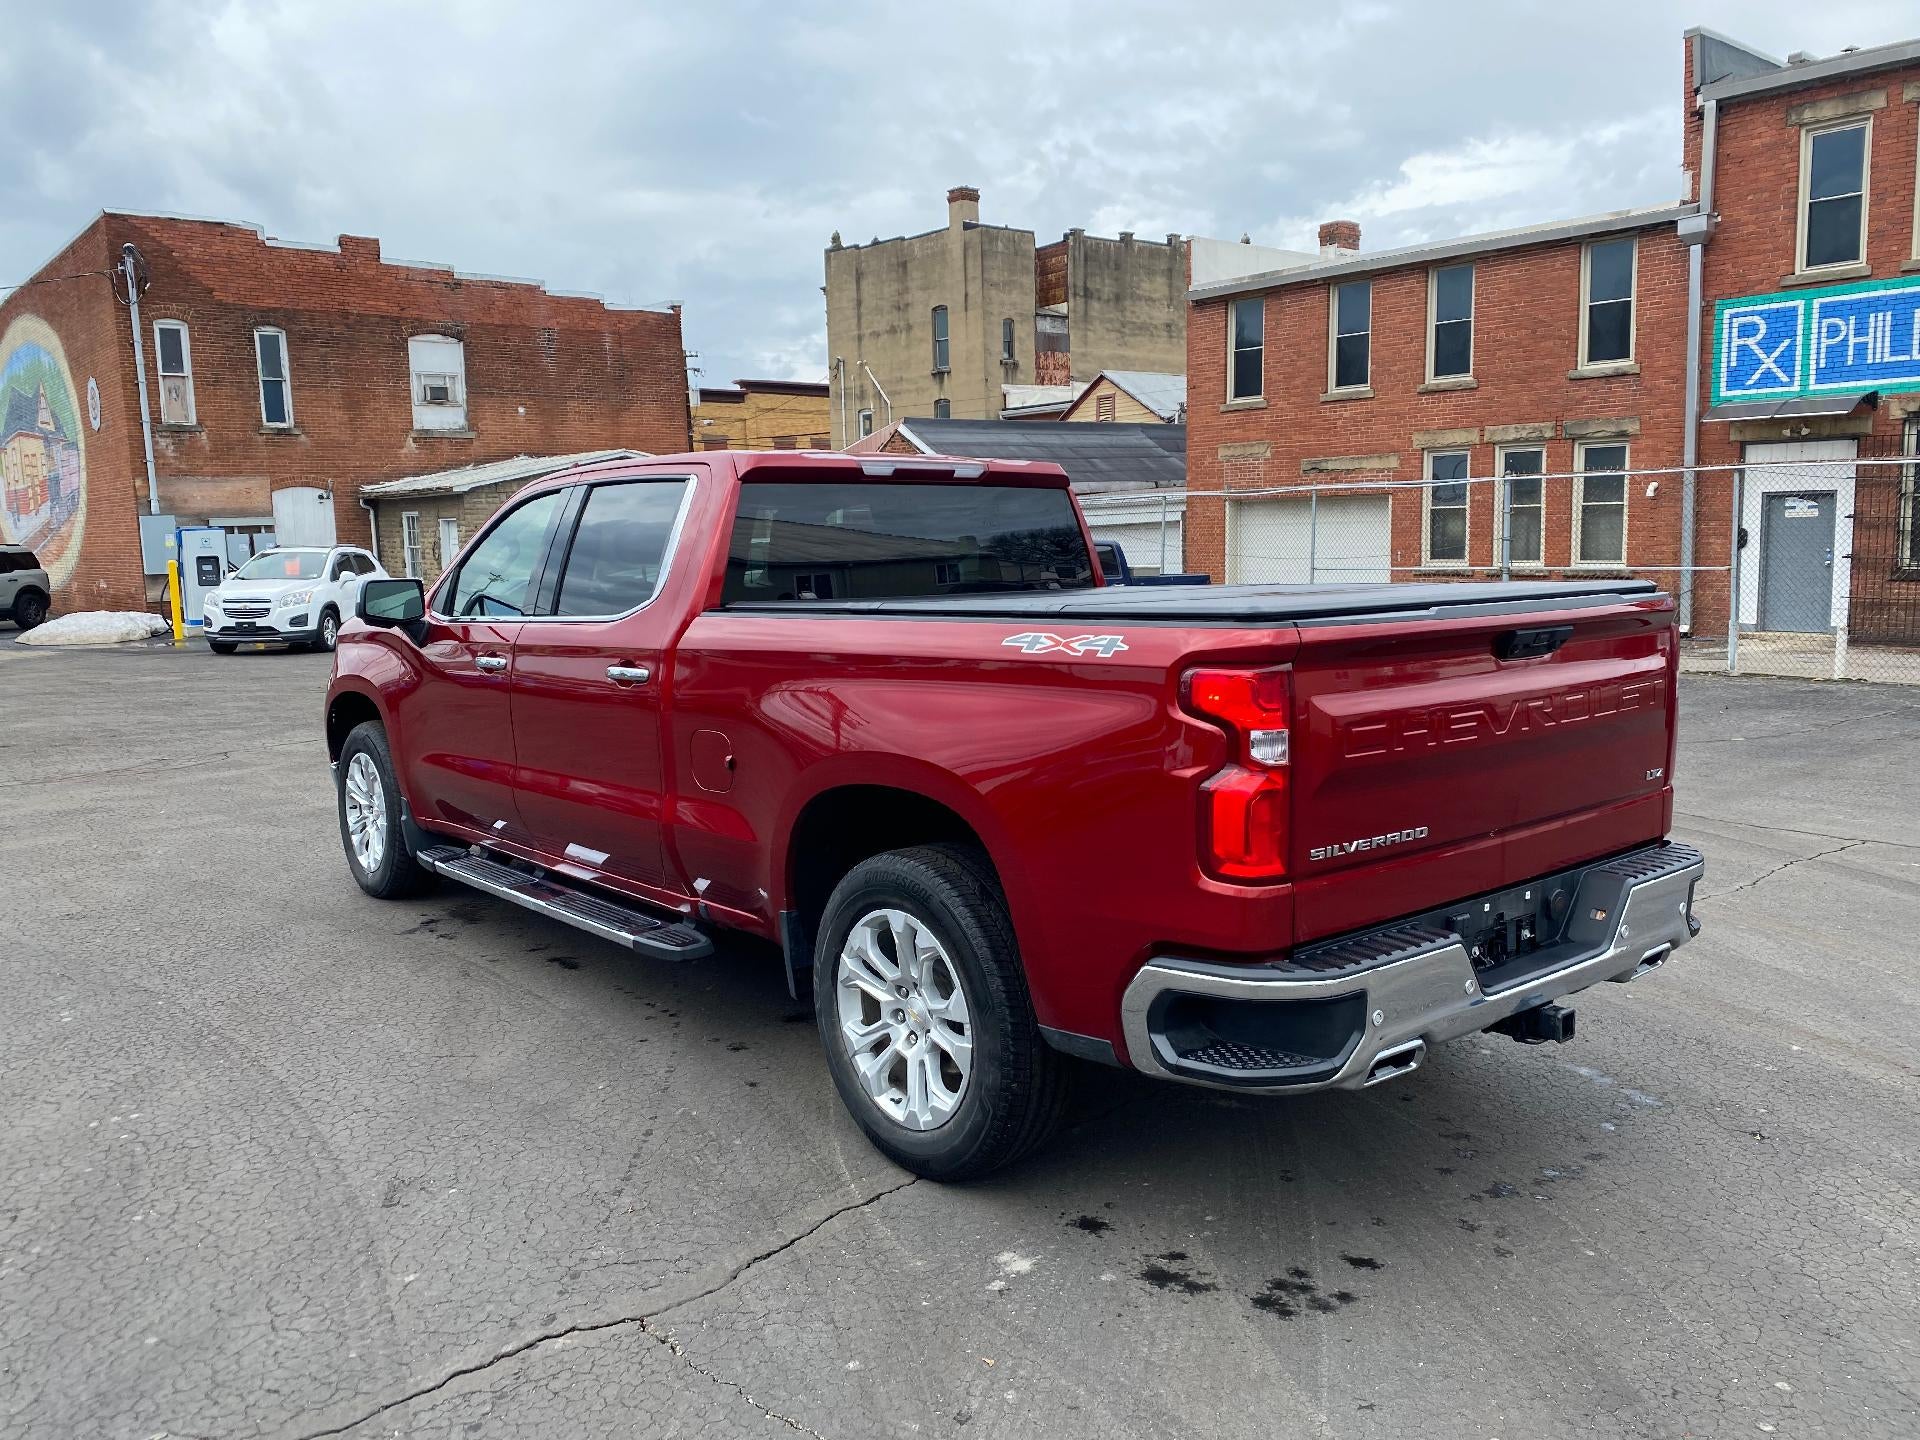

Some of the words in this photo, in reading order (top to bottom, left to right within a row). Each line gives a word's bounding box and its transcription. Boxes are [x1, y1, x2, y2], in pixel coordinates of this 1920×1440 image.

[1344, 676, 1664, 758] CHEVROLET
[1646, 767, 1664, 780] LTZ
[1310, 826, 1429, 861] SILVERADO
